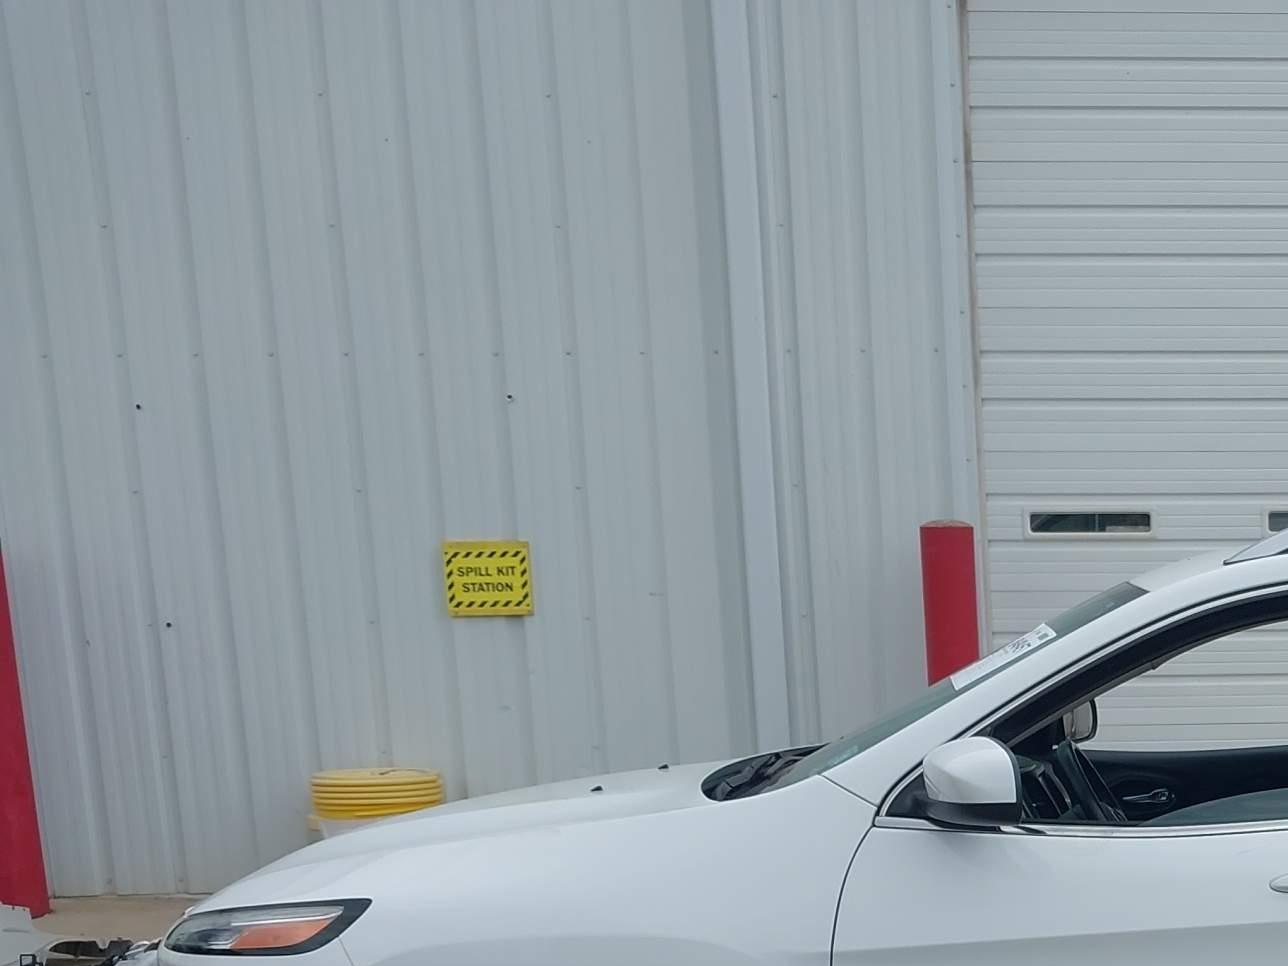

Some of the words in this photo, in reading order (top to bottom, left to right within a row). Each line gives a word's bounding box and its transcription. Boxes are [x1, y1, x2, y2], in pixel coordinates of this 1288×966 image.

[456, 565, 493, 577] SPILL
[496, 565, 517, 577] KIT
[461, 581, 514, 593] STATION
